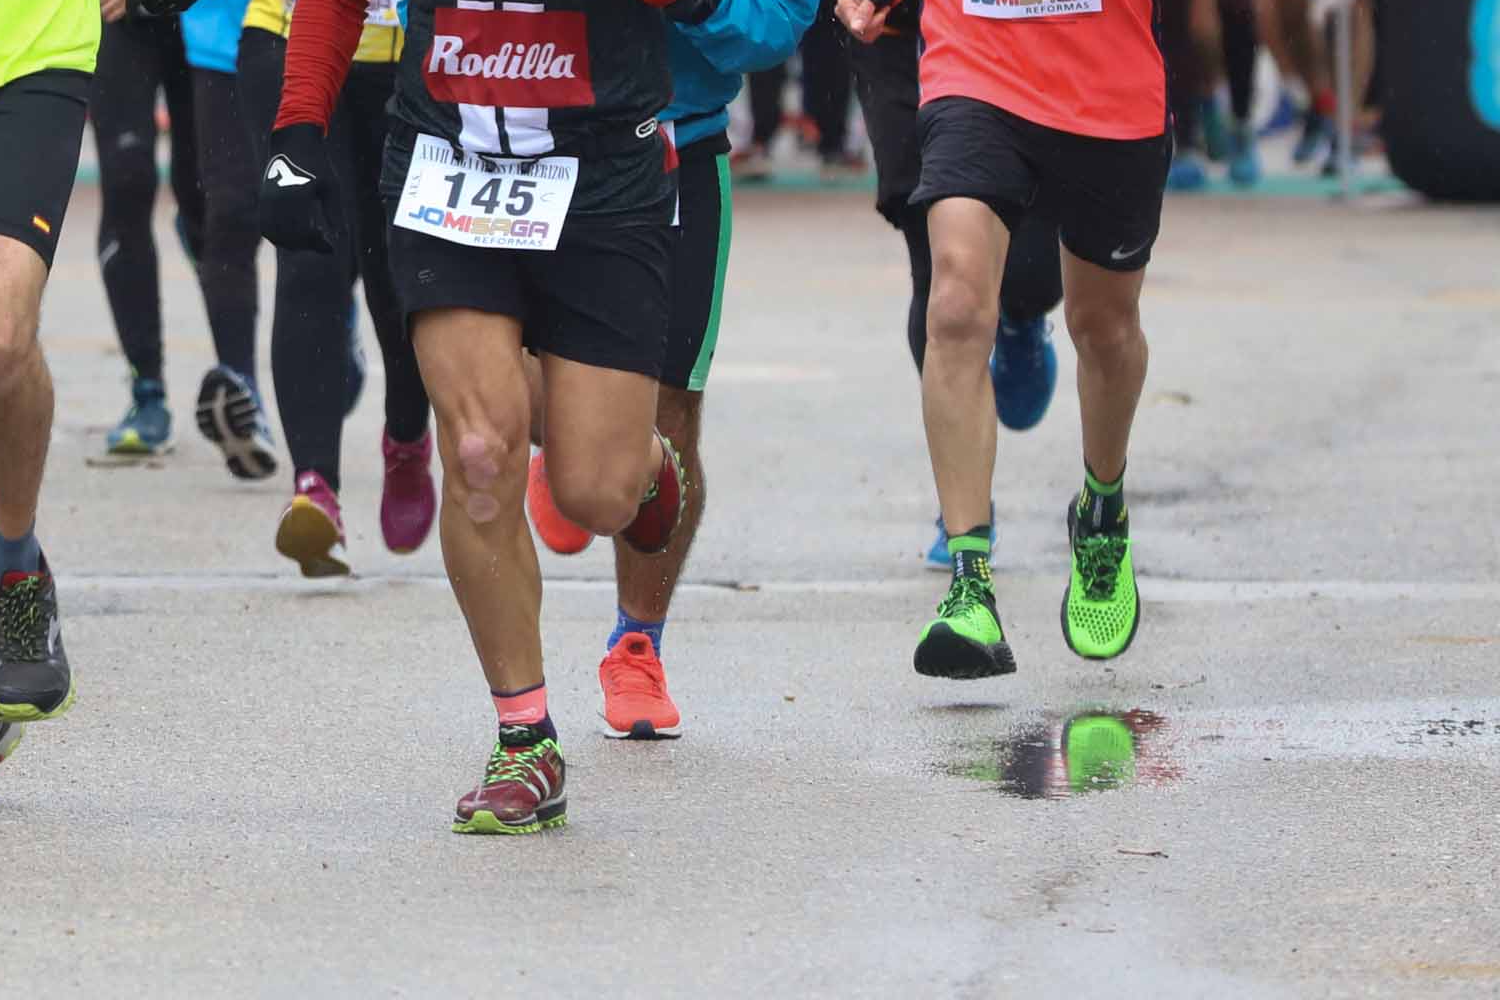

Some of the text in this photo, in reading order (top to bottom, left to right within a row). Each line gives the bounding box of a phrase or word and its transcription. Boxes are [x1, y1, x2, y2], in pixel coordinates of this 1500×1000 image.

[1025, 1, 1090, 15] REFORMAS
[427, 33, 577, 81] Rodilla
[444, 171, 537, 217] 145
[408, 204, 550, 240] JOMISAGA
[473, 236, 544, 248] REFORMAS
